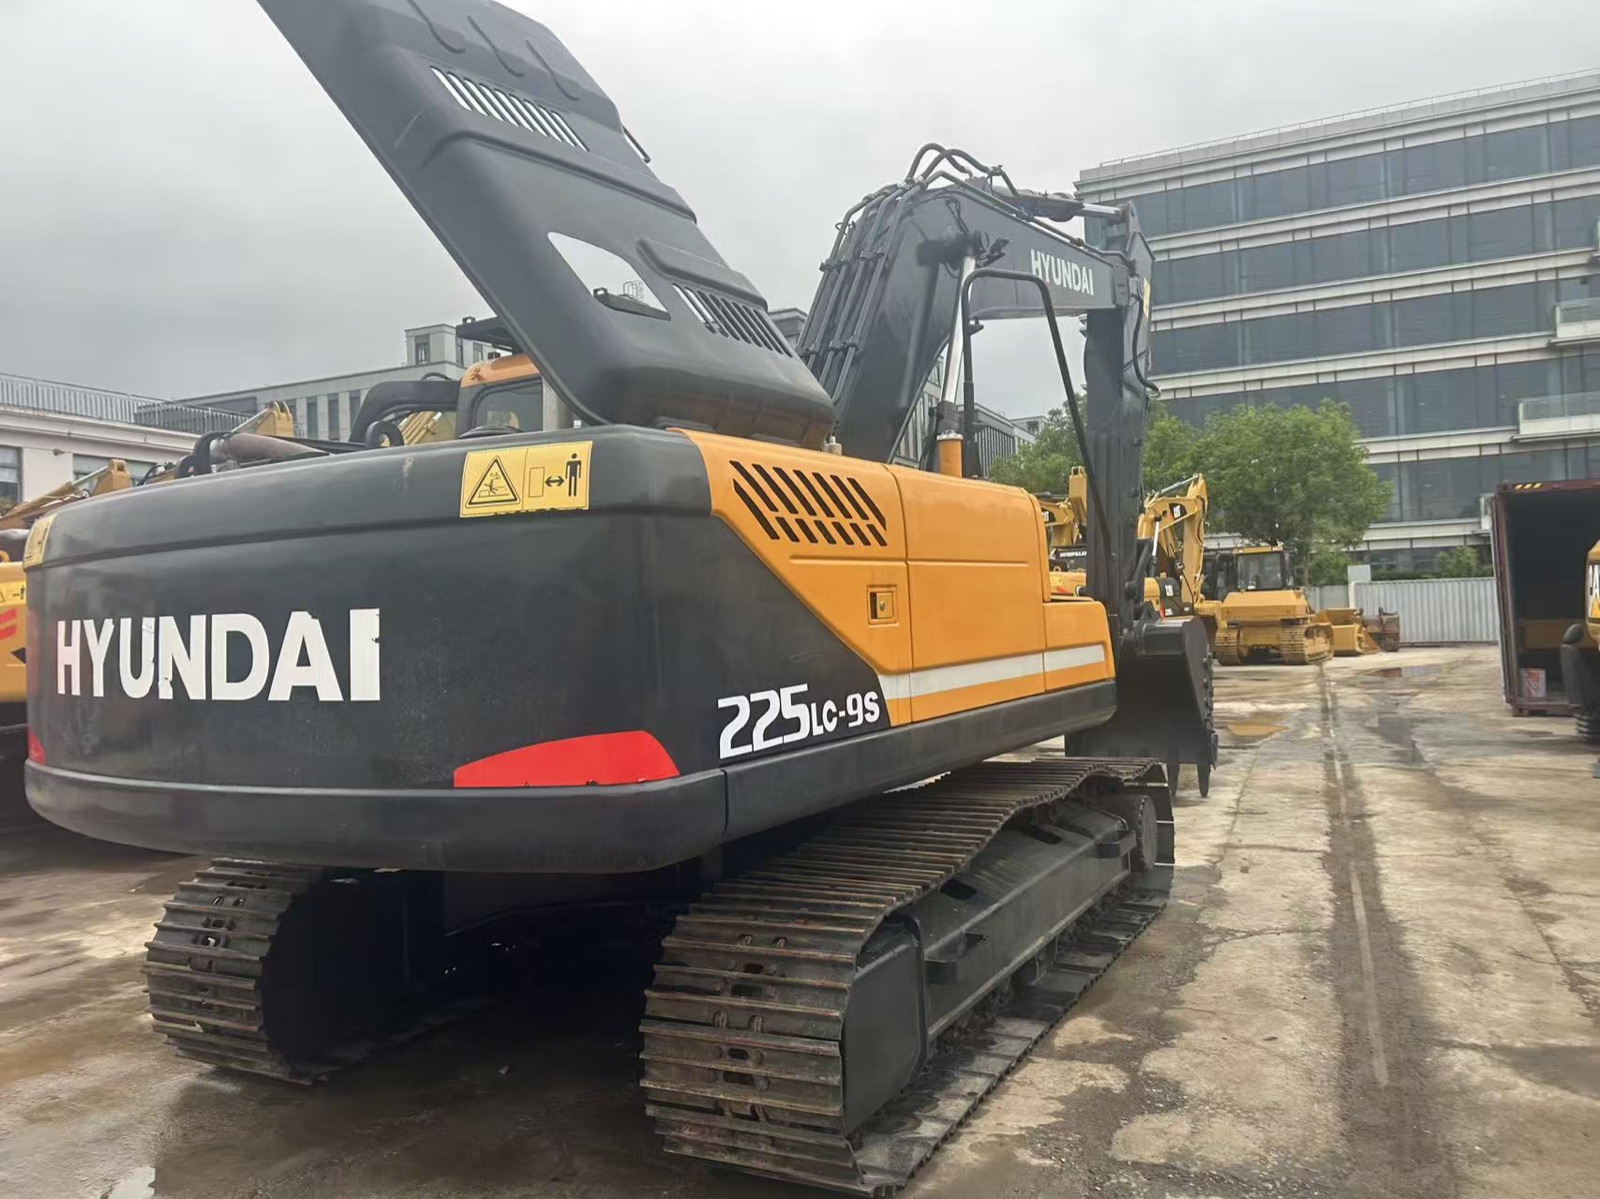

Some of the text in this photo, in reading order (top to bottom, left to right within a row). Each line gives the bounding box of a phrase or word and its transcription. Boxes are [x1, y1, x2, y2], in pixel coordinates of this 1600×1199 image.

[1030, 249, 1094, 296] HYUNDAI
[57, 608, 380, 701] HYUNDAI
[717, 683, 880, 759] 225LC-9S
